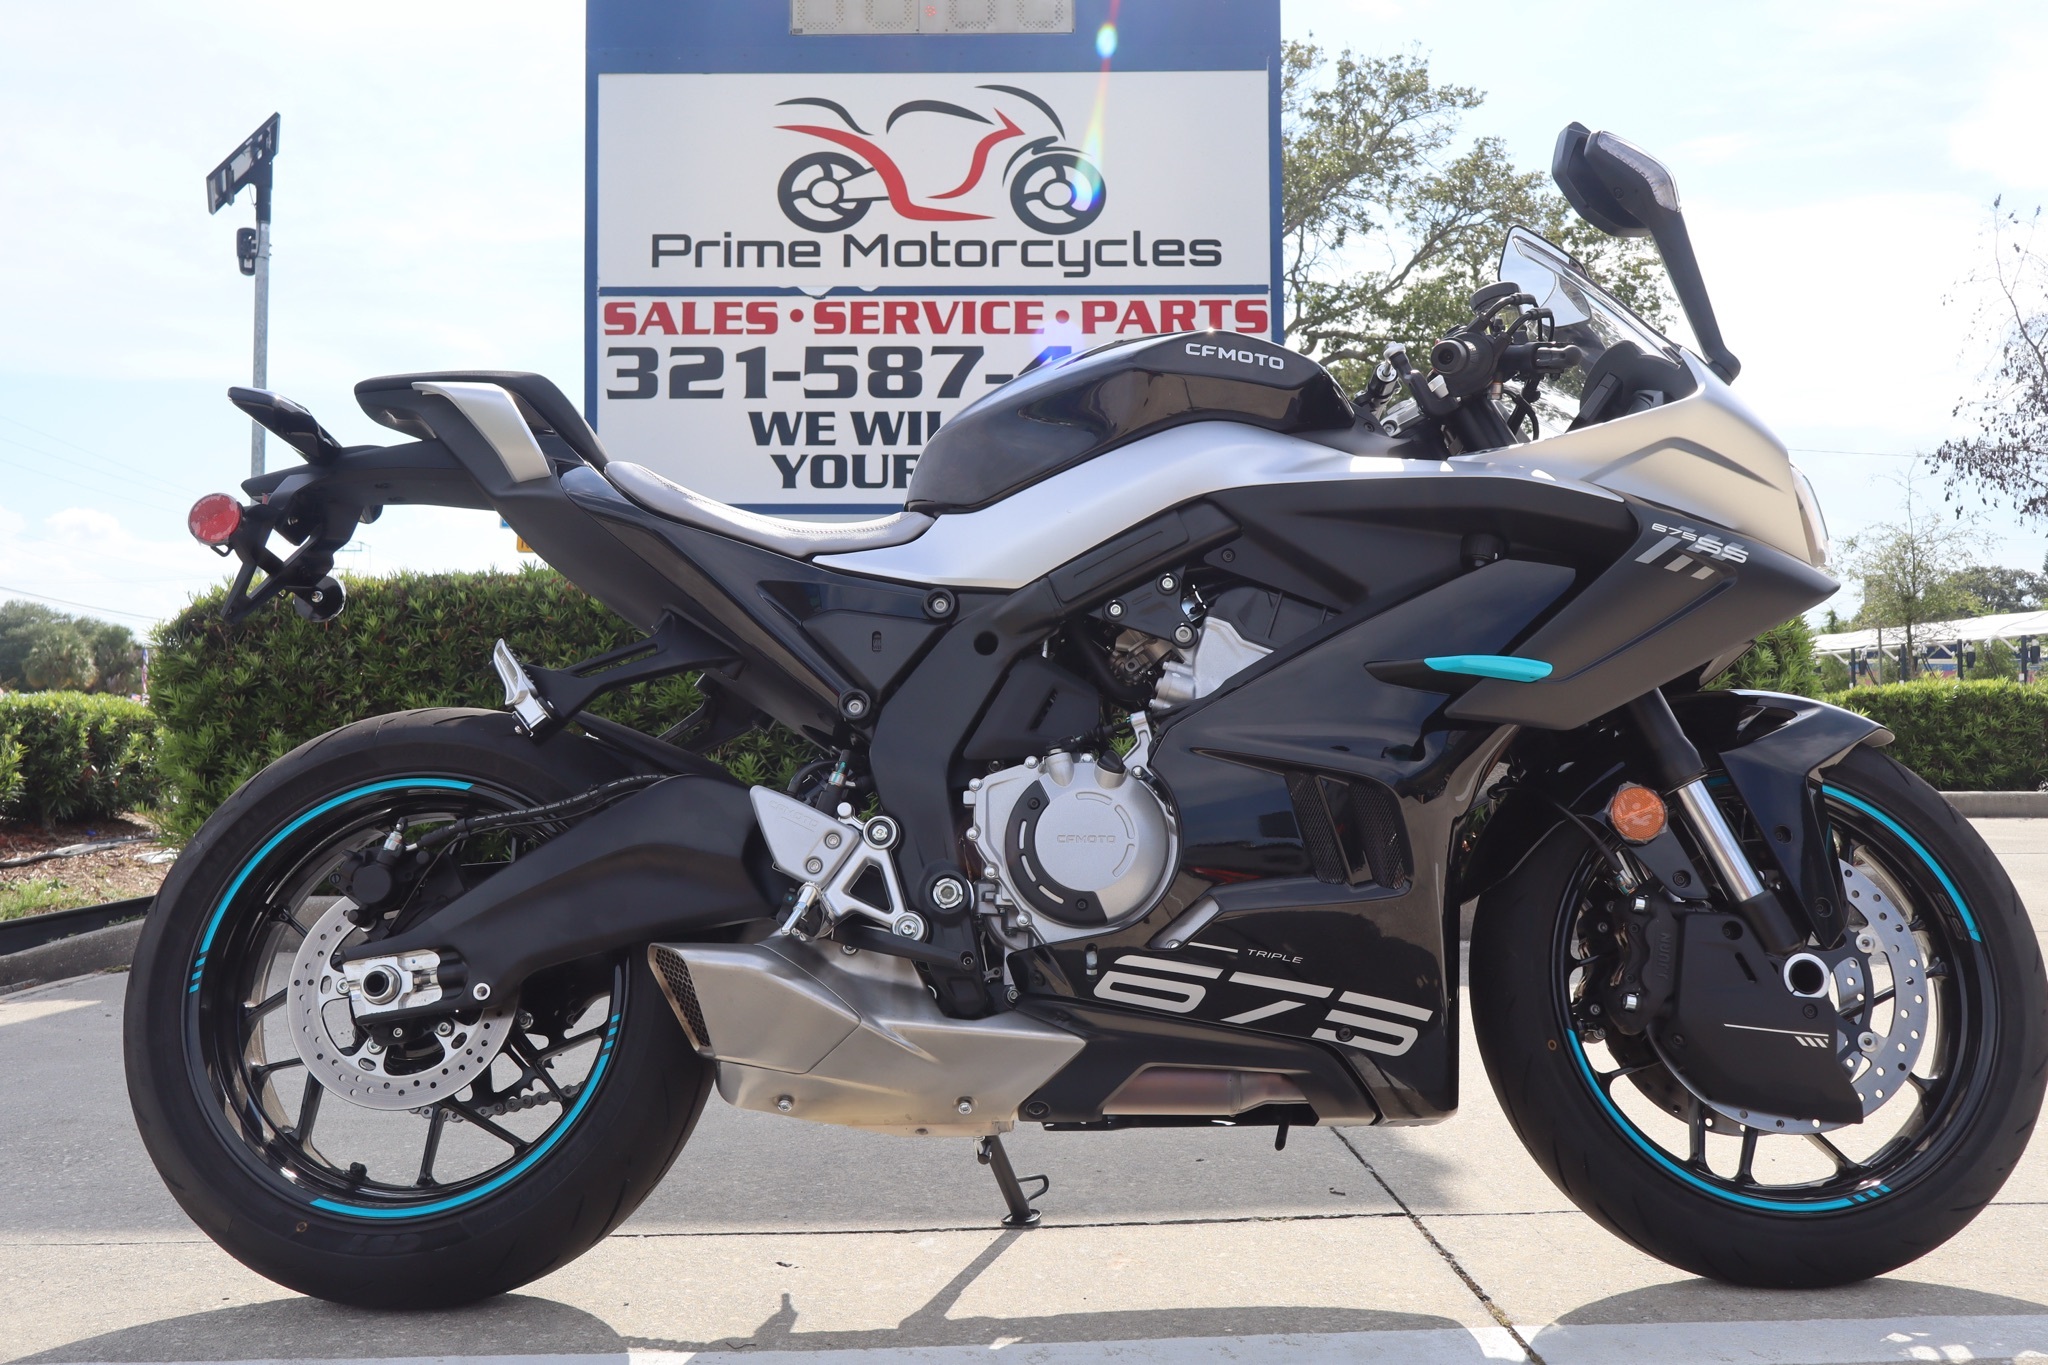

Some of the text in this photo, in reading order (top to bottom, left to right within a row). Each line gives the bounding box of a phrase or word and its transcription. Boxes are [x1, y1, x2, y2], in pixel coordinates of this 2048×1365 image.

[651, 229, 1222, 278] Prime Motorcycles
[604, 299, 1268, 335] SALES SERVICE PARTS
[1185, 342, 1284, 370] CFMOTO
[747, 411, 837, 446] WE
[1056, 834, 1116, 844] CFMOTO
[1246, 948, 1304, 965] TRIPLE
[1093, 954, 1434, 1058] 675
